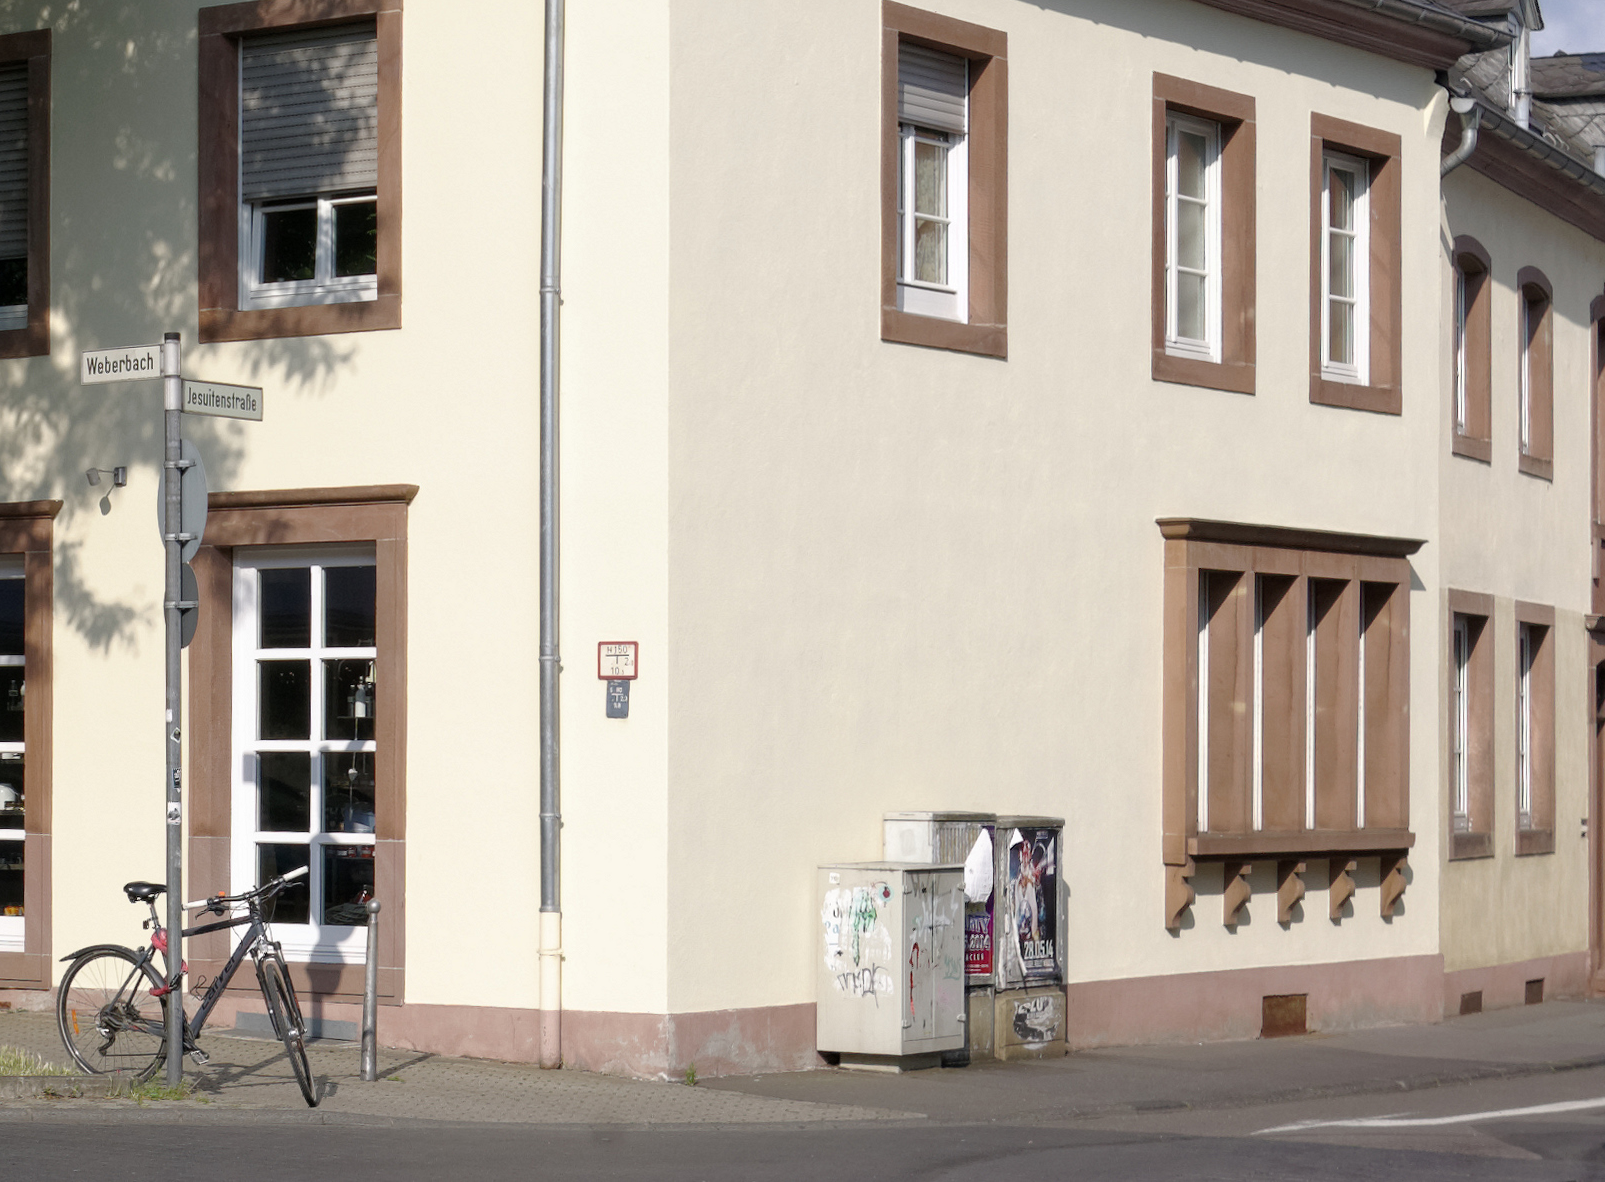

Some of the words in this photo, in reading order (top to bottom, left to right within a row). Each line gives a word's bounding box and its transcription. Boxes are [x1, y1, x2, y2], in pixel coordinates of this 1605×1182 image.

[86, 352, 154, 375] Weberbach
[187, 387, 257, 412] Jesuitenstraße
[1023, 939, 1054, 959] 28.05.14
